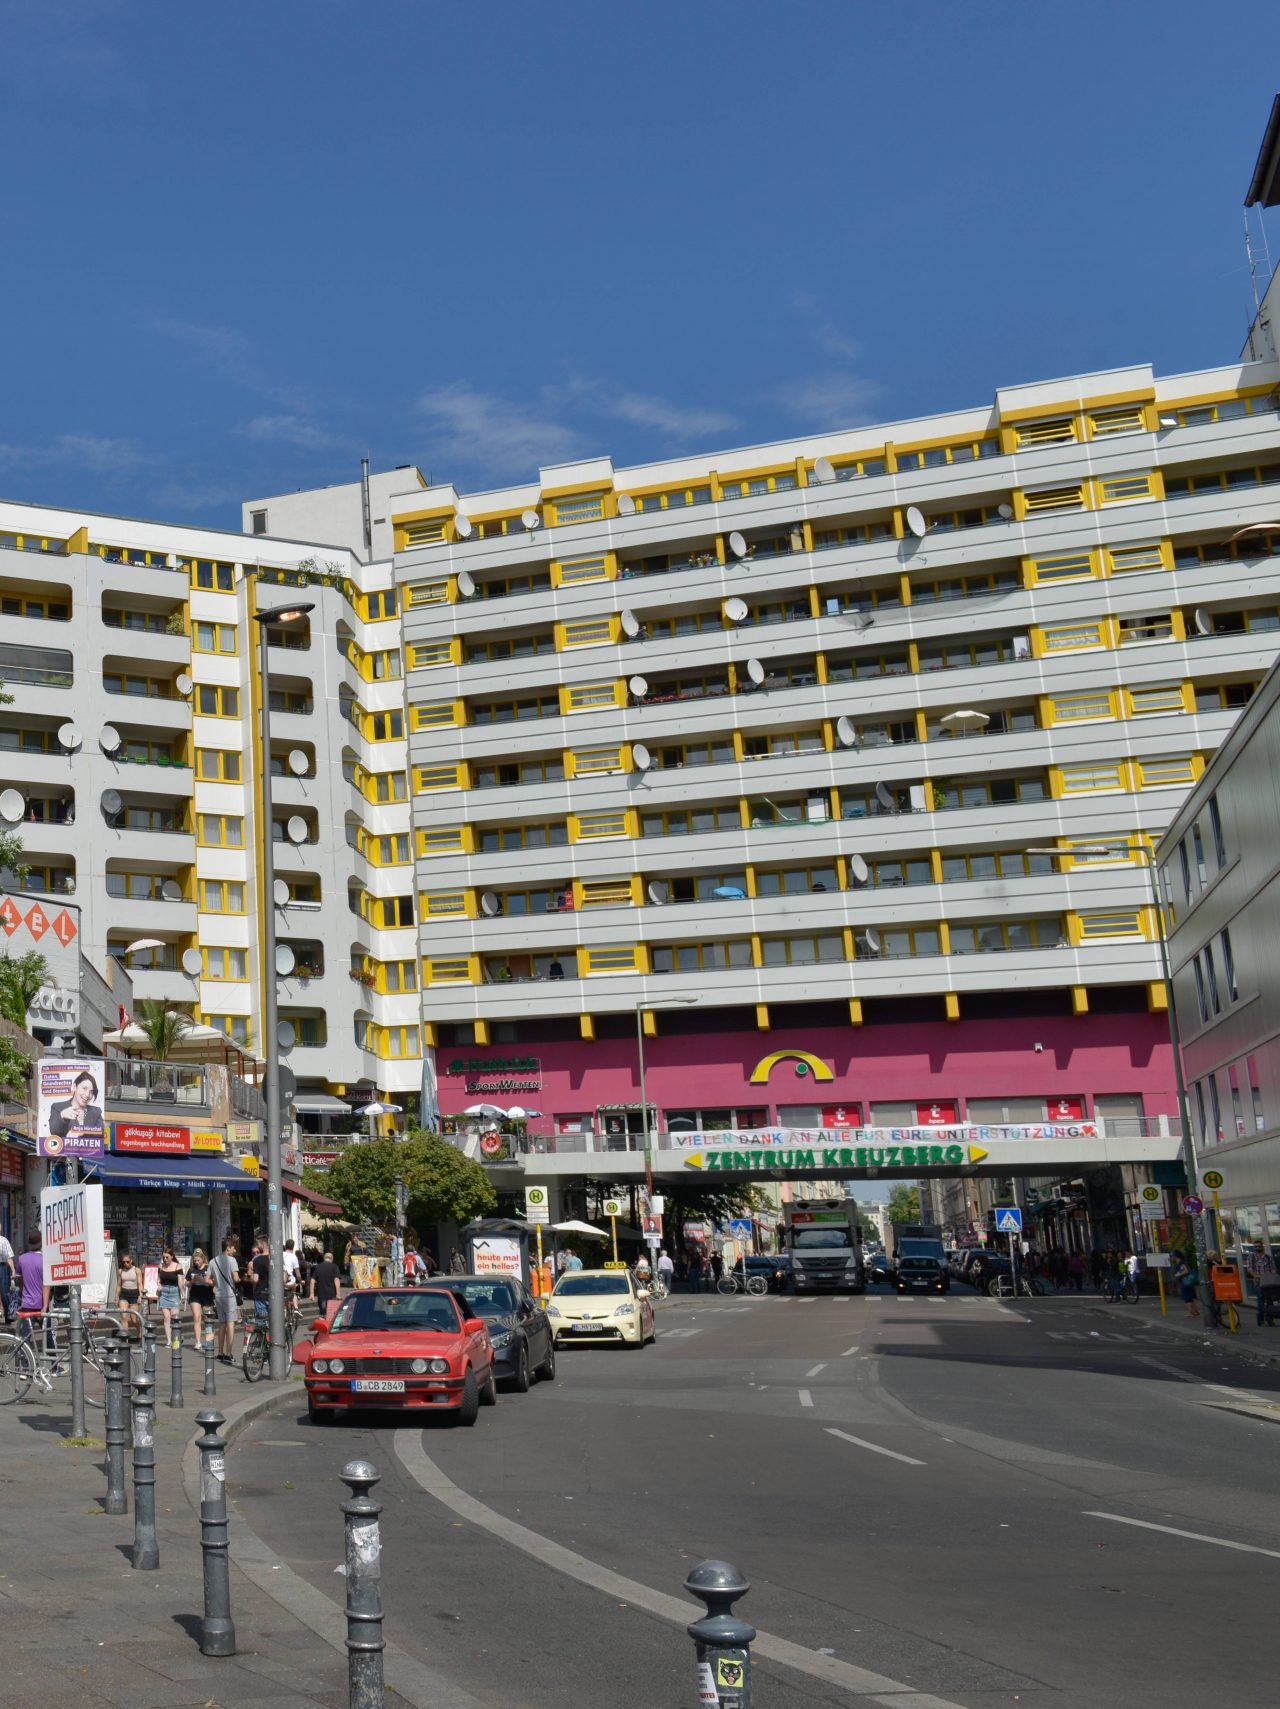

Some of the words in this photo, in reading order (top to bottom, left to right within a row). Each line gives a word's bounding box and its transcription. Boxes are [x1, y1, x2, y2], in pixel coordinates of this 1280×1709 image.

[156, 1129, 181, 1138] kitabevi
[676, 1132, 732, 1147] VIELEN
[739, 1132, 783, 1145] DANK
[789, 1130, 811, 1143] AN
[817, 1129, 850, 1143] ALLE
[891, 1128, 932, 1141] EURE
[64, 1138, 100, 1147] PIRATEN
[120, 1140, 150, 1148] regenbogen
[201, 1136, 220, 1146] LOTTO
[705, 1150, 816, 1170] ZENTRUM
[822, 1145, 964, 1168] KREUZBERG
[139, 1179, 161, 1188] Türkçe
[164, 1179, 180, 1188] Kitap
[45, 1191, 84, 1247] RESPEKT
[477, 1253, 501, 1261] heute
[53, 1266, 64, 1278] DIE
[381, 1381, 404, 1390] 2849
